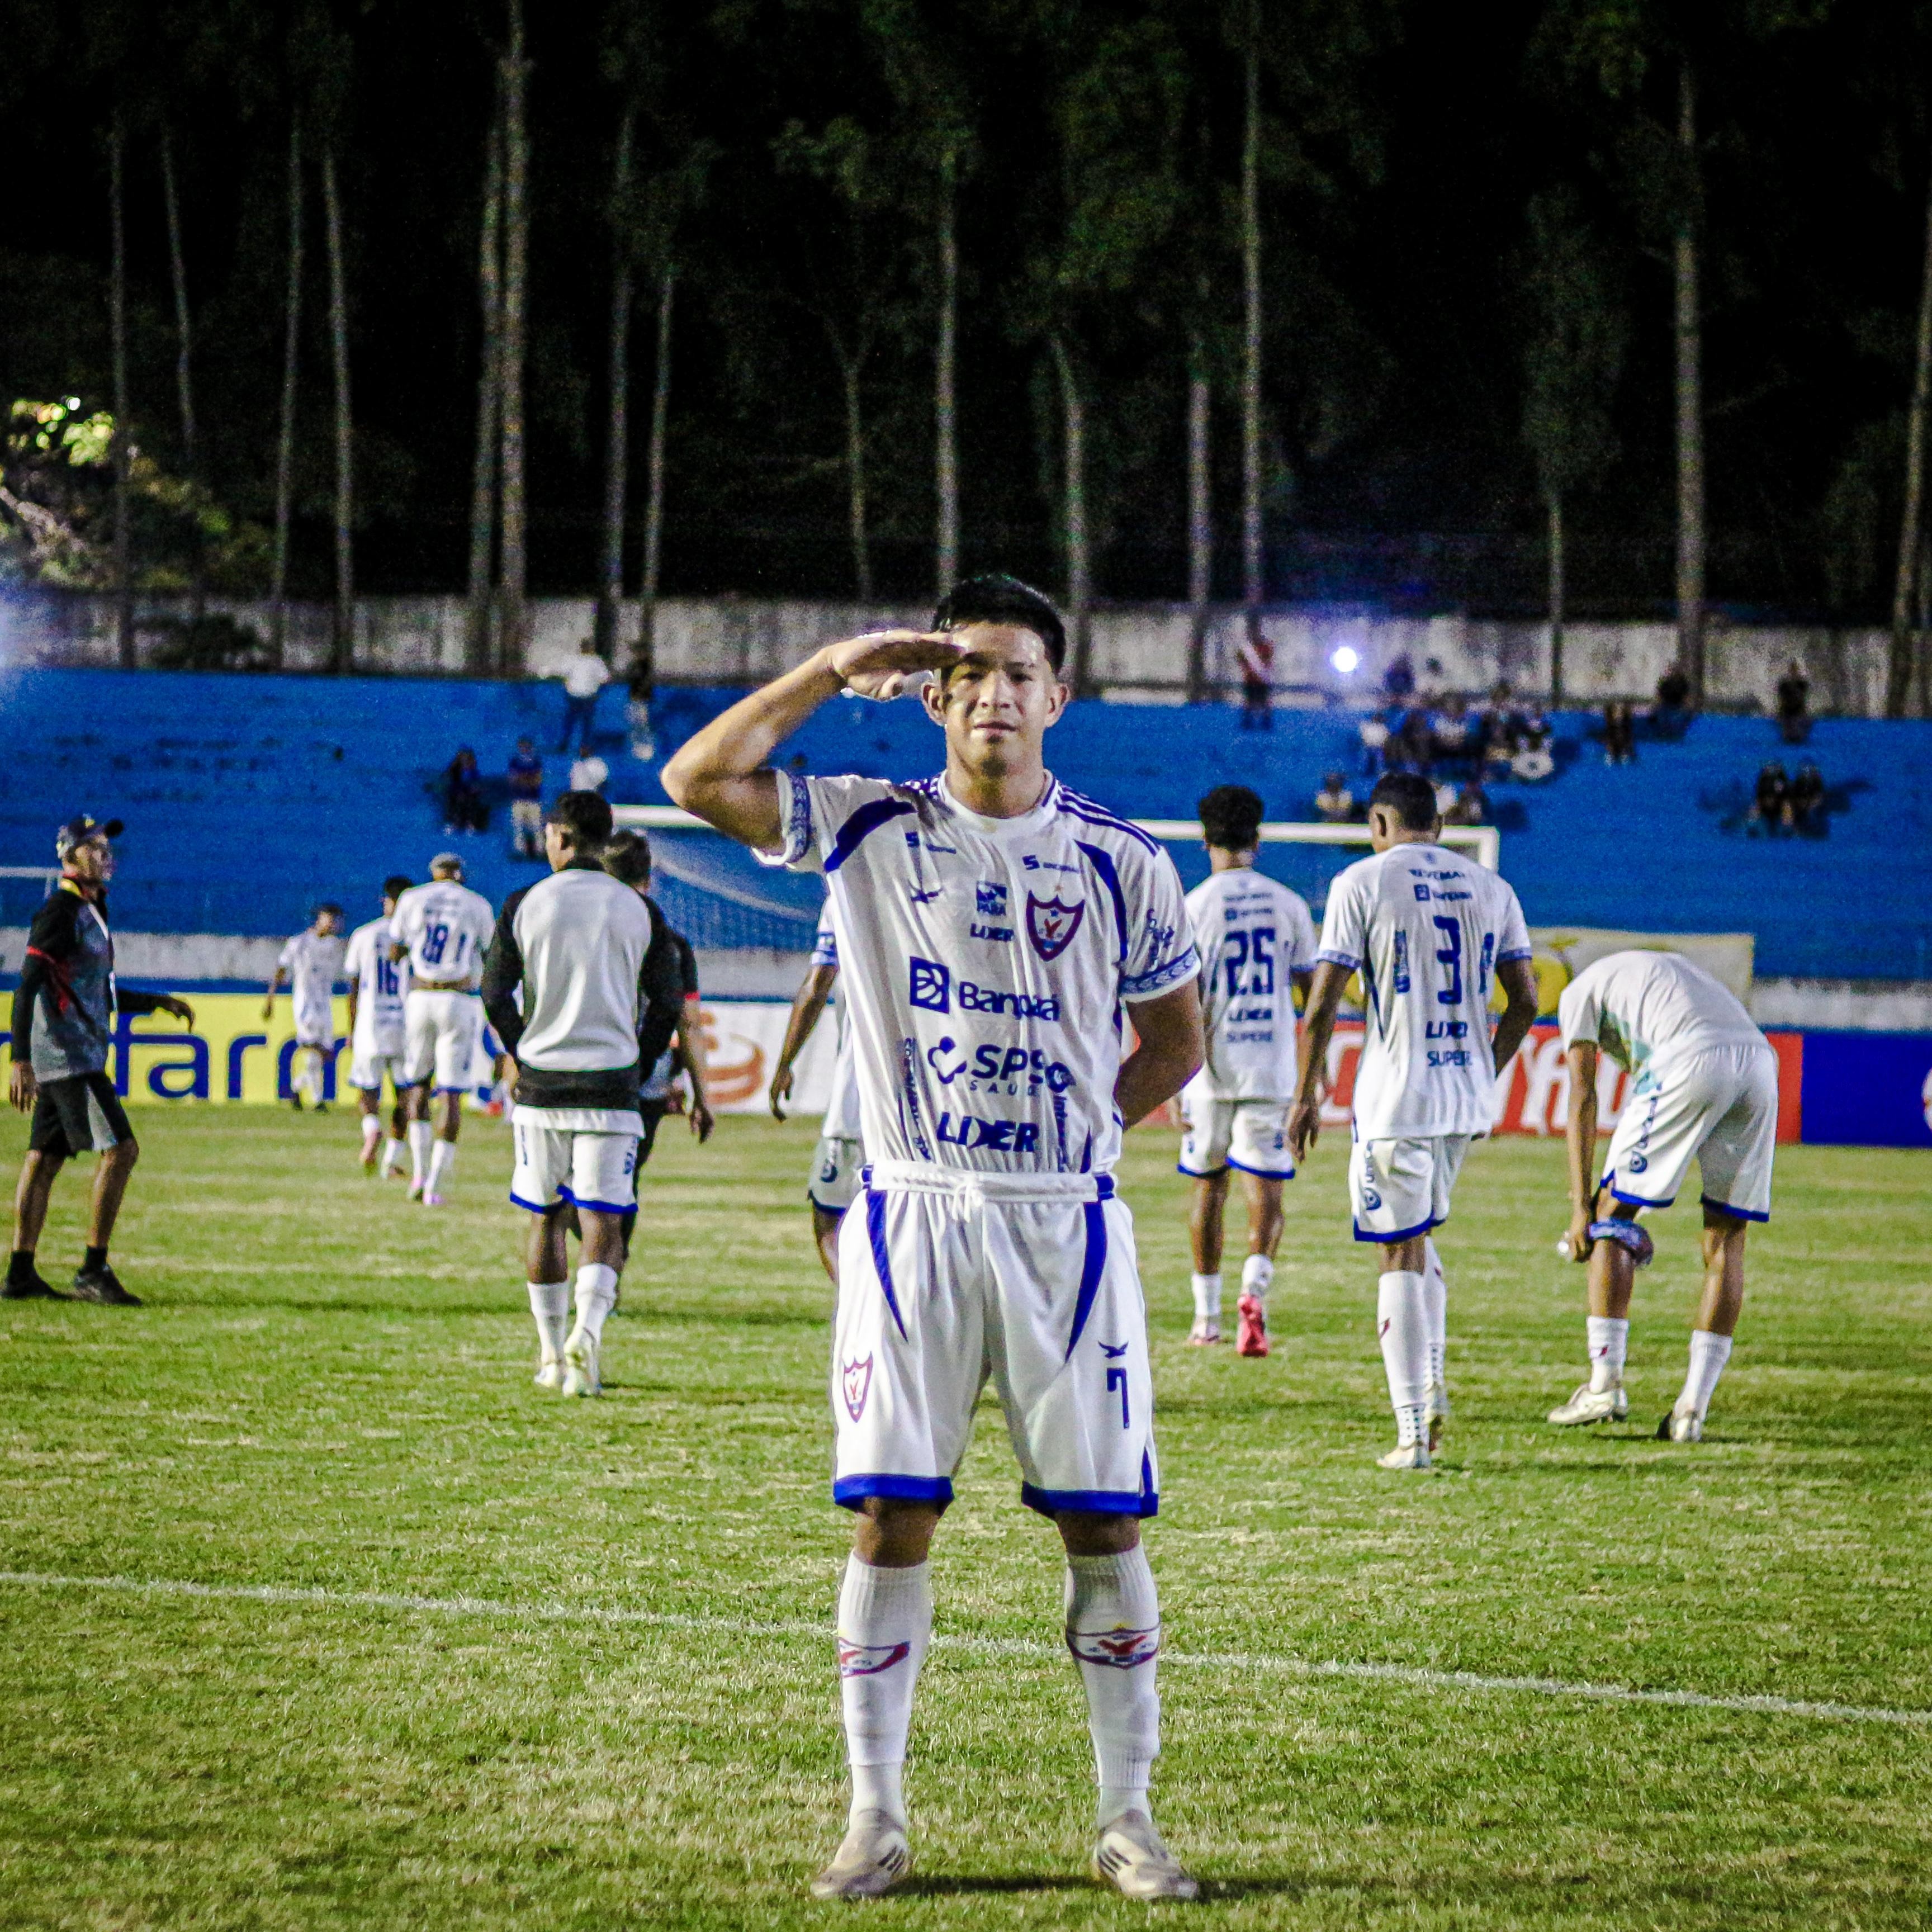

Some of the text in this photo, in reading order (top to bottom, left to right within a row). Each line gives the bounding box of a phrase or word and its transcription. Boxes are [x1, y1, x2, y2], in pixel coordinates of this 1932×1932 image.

[377, 955, 399, 996] 16
[1224, 926, 1276, 996] 25
[1433, 914, 1462, 1005] 3
[1107, 1368, 1130, 1429] 7
